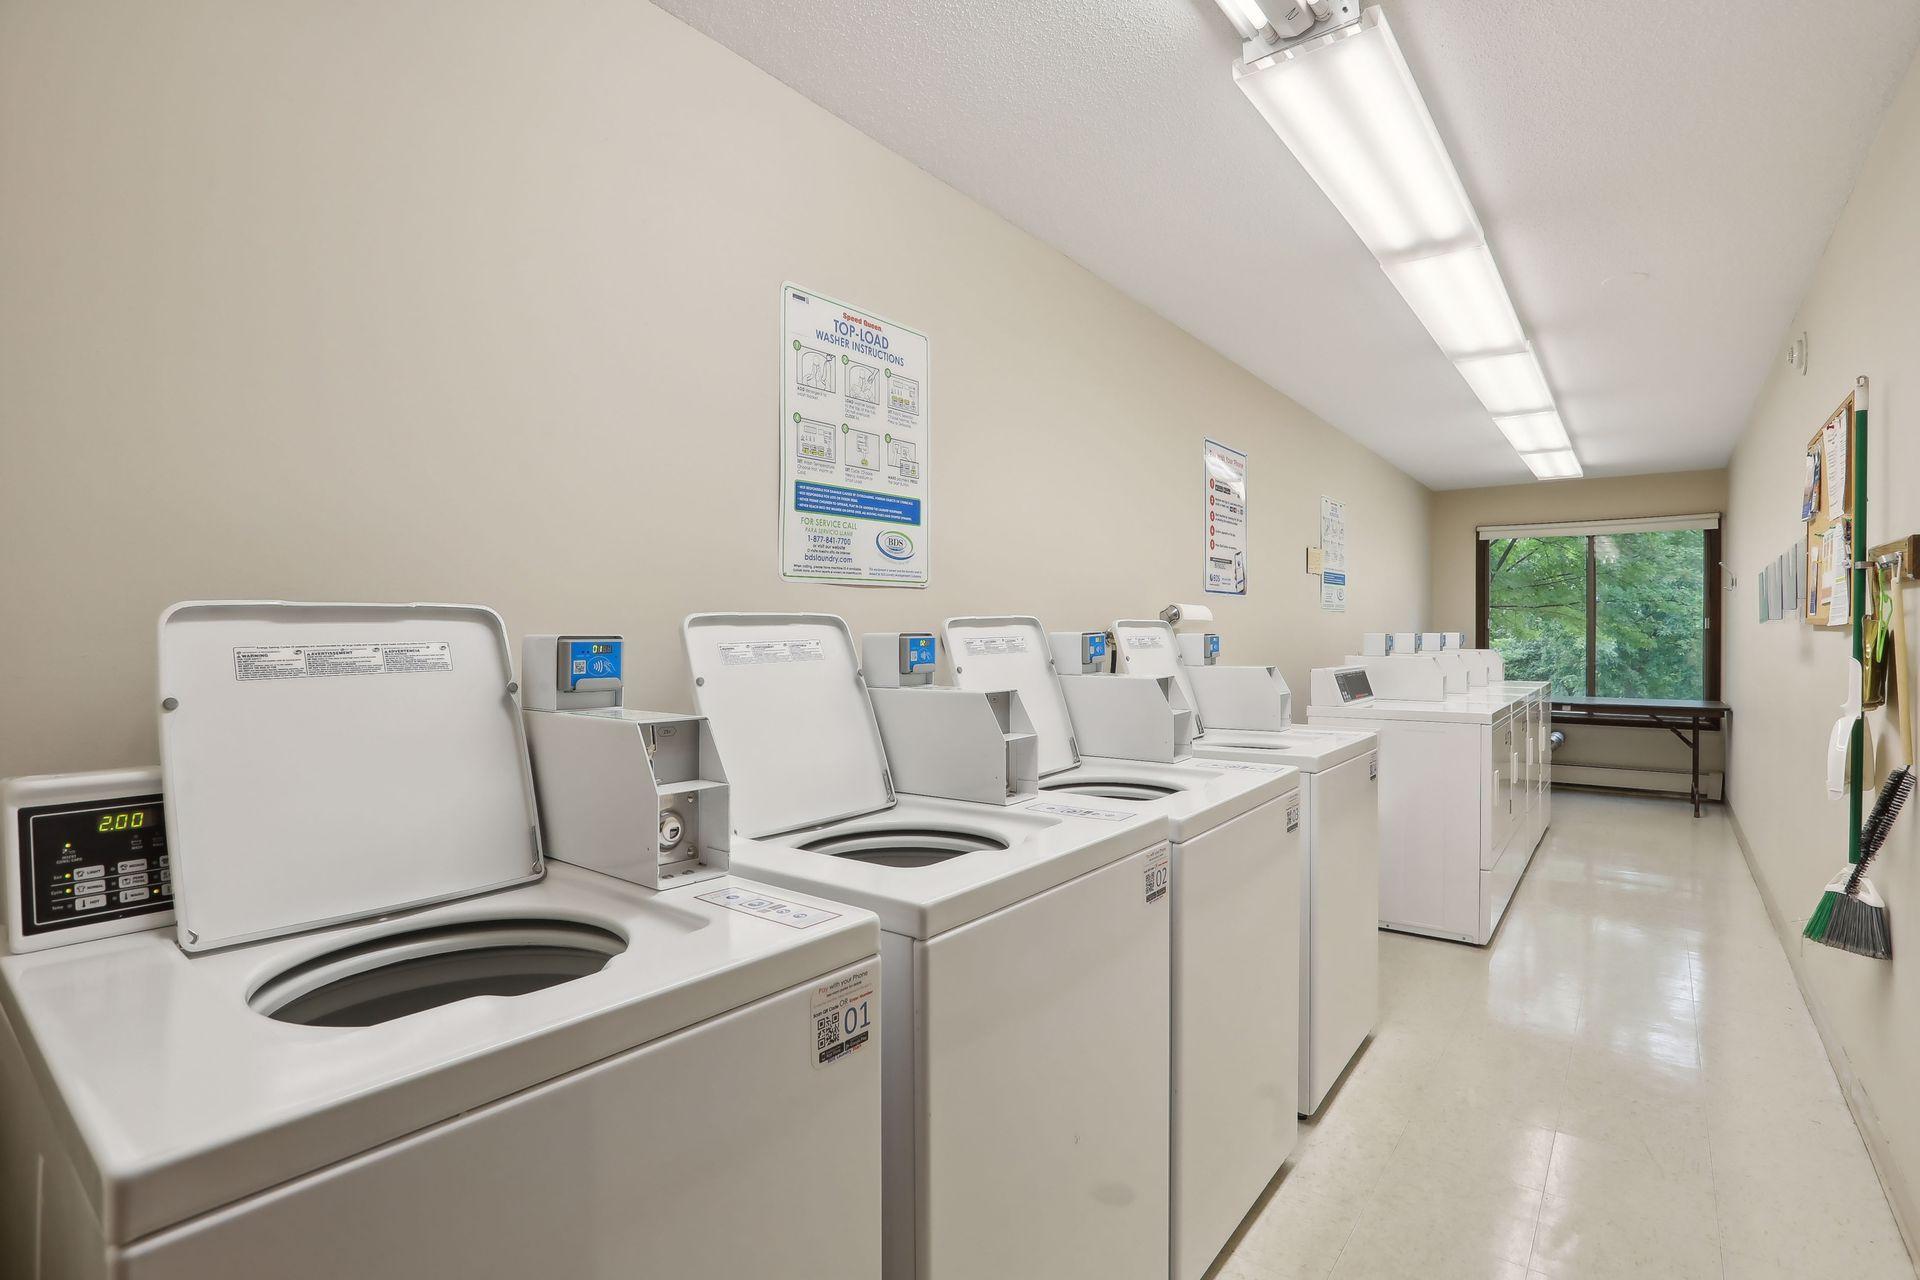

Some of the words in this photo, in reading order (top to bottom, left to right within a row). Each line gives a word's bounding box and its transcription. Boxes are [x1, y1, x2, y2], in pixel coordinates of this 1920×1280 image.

[842, 312, 862, 324] Speed
[864, 320, 882, 331] Queen
[833, 319, 889, 349] TOP-LOAD
[816, 329, 850, 348] WASHER
[852, 341, 904, 367] INSTRUCTIONS
[800, 517, 814, 525] FOR
[816, 519, 841, 529] SERVICE
[842, 522, 857, 530] CALL
[808, 535, 851, 545] 1-877-841-7700
[888, 538, 903, 546] BDS
[805, 553, 853, 564] bdslaundry.com
[98, 812, 144, 832] 2.00
[1156, 867, 1167, 888] 02
[818, 986, 828, 995] Pay
[841, 977, 852, 987] your
[853, 971, 868, 981] Phone
[813, 1010, 822, 1018] Scan
[839, 998, 848, 1007] OR
[844, 1001, 871, 1035] 01
